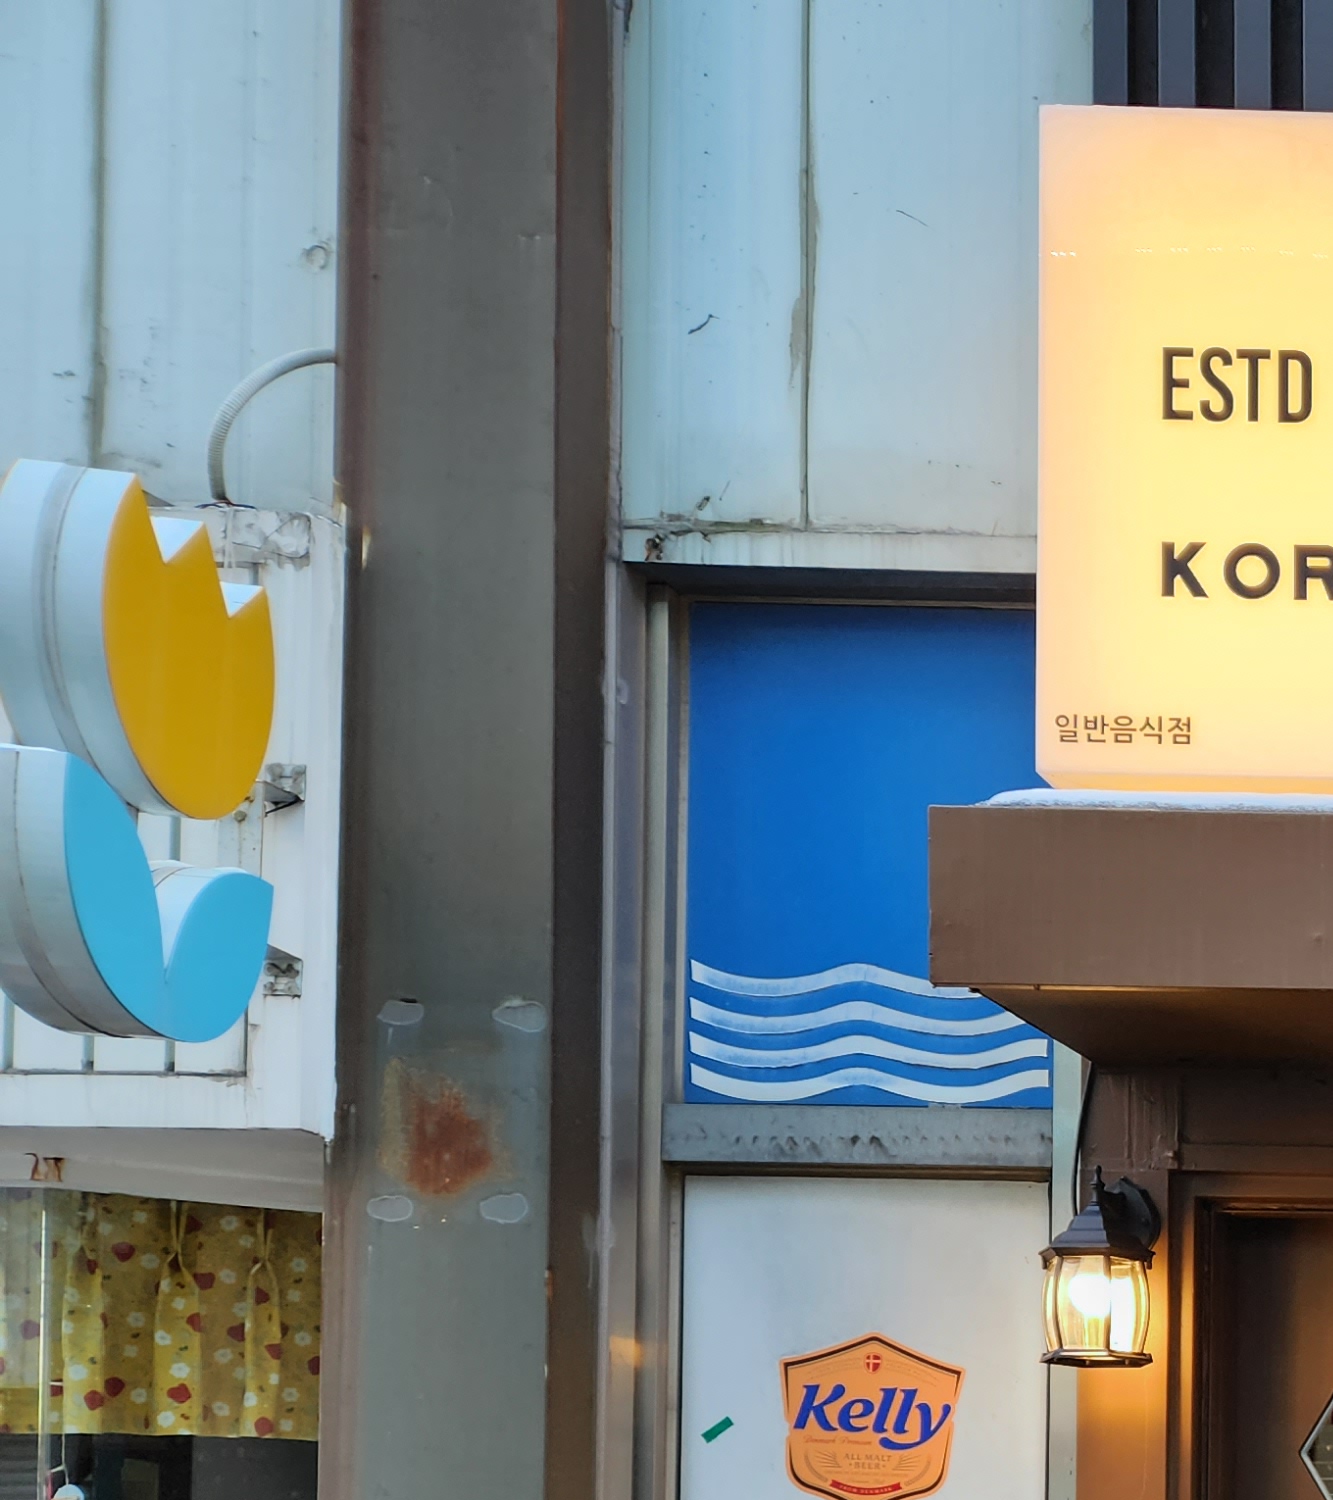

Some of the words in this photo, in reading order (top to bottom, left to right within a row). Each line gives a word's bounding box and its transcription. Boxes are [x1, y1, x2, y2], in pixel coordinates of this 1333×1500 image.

[1161, 346, 1315, 425] ESTD
[1054, 710, 1193, 747] 일반음식점
[793, 1383, 952, 1451] Kelly
